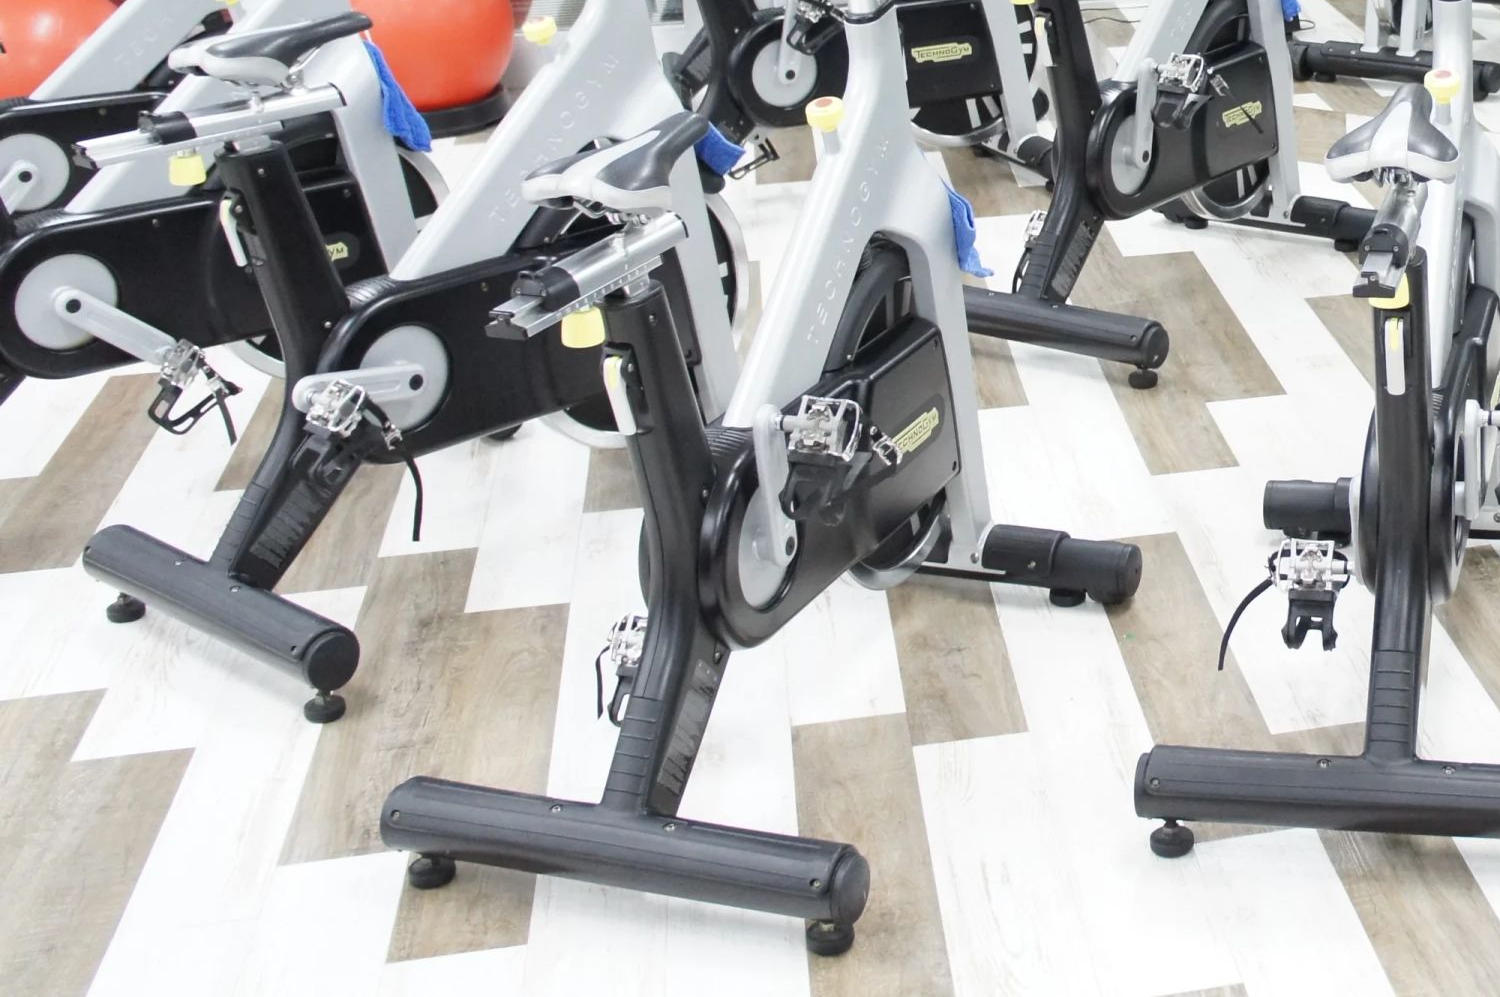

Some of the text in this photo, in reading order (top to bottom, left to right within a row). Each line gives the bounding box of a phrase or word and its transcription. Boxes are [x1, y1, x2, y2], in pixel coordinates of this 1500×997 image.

[914, 46, 970, 59] TECHNOGYM
[806, 139, 889, 345] TECHNOGYM
[895, 411, 938, 451] ECHNOGYM
